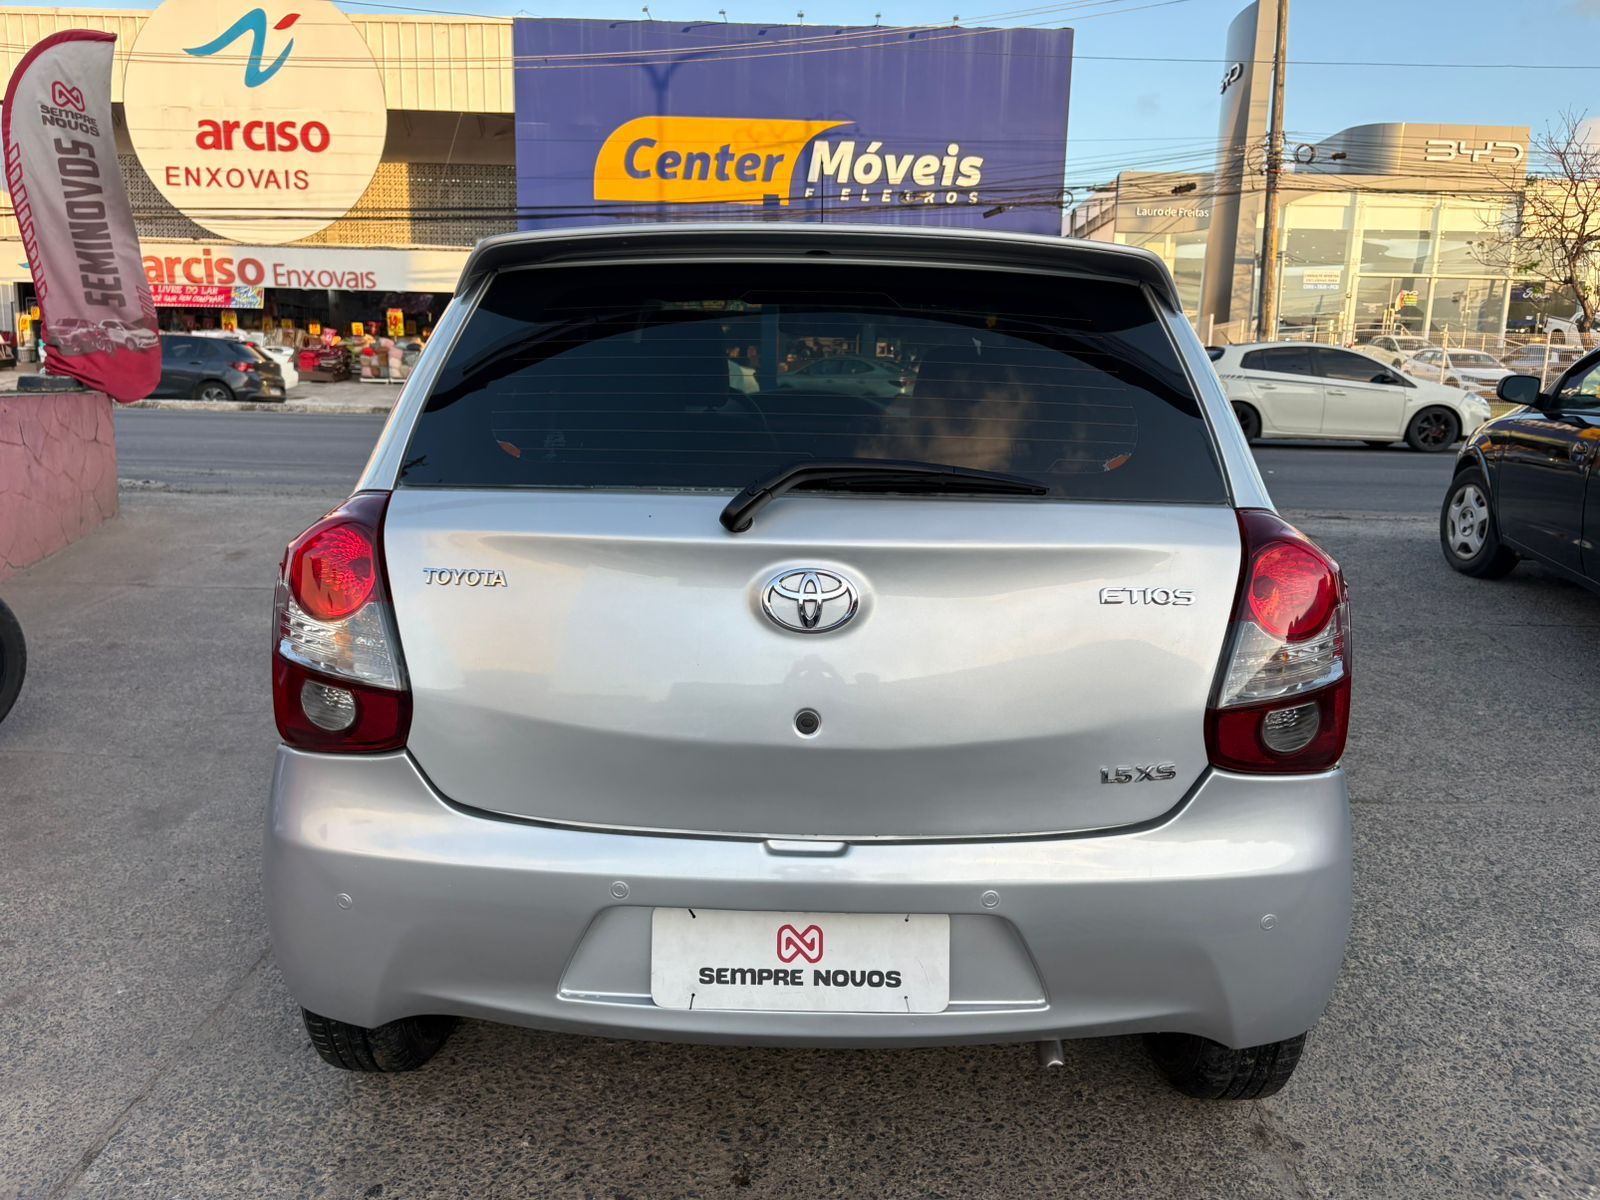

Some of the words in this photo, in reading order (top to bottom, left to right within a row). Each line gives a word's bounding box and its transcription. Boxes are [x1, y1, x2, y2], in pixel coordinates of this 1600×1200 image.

[40, 104, 98, 127] SEMPRE
[41, 114, 100, 137] NOVOS
[195, 119, 331, 153] arciso
[624, 138, 784, 182] Center
[807, 140, 984, 187] Móveis
[1424, 140, 1524, 162] BYD
[165, 166, 309, 190] ENXOVAIS
[54, 137, 127, 308] SEMINOVOS
[1136, 207, 1163, 216] Lauro
[1164, 207, 1177, 217] de
[1178, 207, 1209, 217] Freitas
[273, 263, 377, 289] Enxovais
[186, 287, 199, 295] DO
[423, 567, 508, 587] TOYOTA
[1099, 587, 1196, 606] ETIOS
[699, 967, 804, 986] SEMPRE
[813, 969, 902, 988] NOVOS
